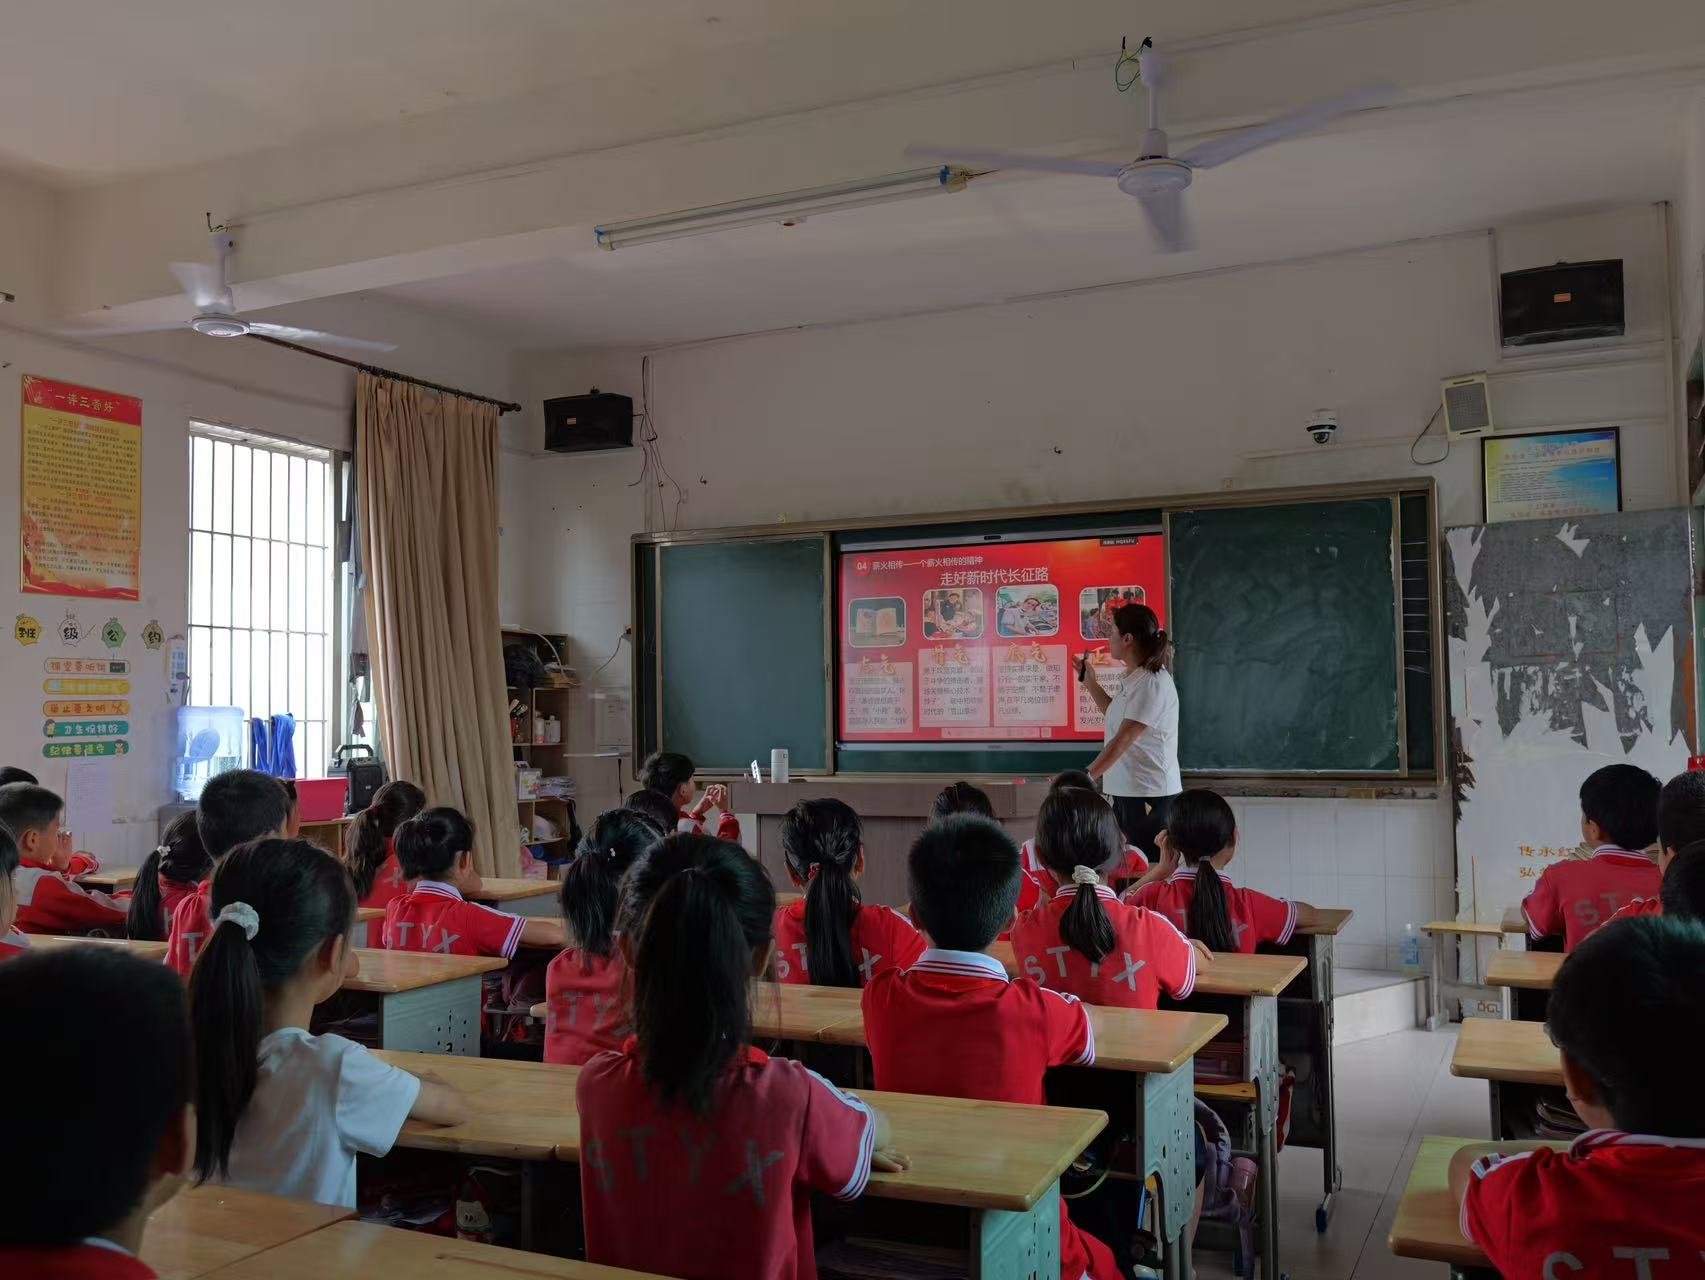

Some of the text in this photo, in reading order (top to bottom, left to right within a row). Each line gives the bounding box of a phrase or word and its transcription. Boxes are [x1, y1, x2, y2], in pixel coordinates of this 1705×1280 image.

[856, 563, 868, 571] 04
[940, 567, 1049, 586] 走好新时代长征路
[587, 1125, 784, 1208] STYX
